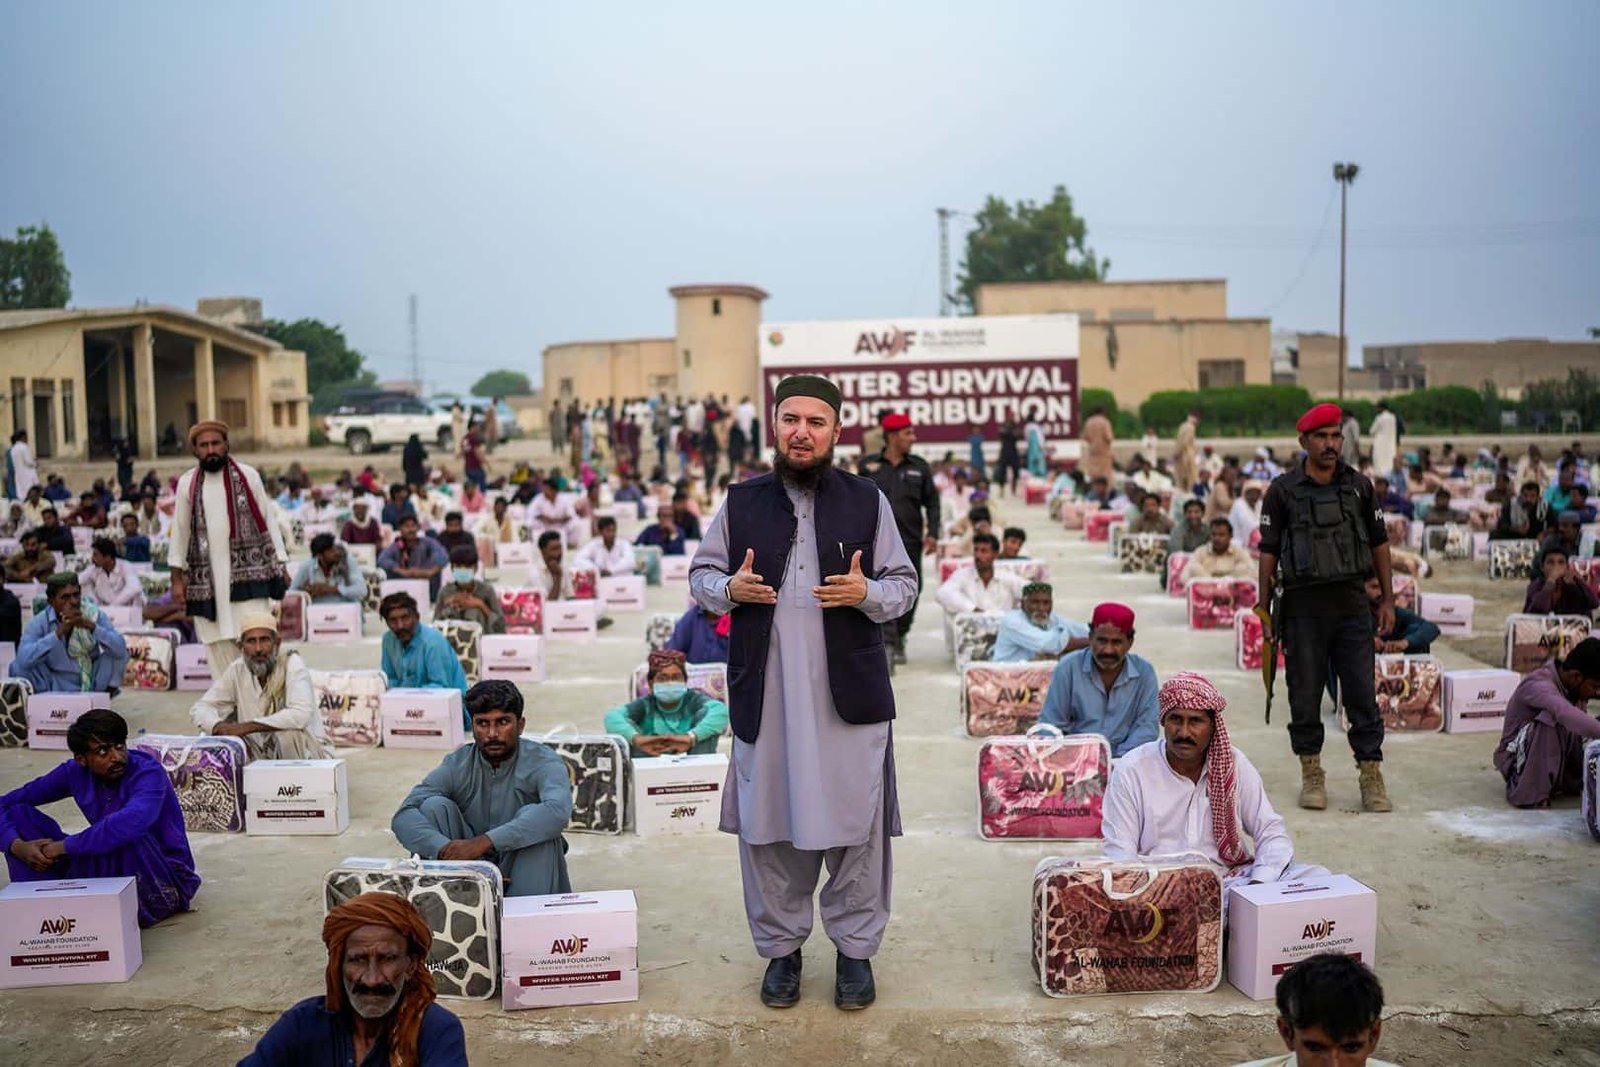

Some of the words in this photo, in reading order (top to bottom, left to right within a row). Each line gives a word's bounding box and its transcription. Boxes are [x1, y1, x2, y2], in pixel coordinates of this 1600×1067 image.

[855, 328, 917, 357] AWF
[907, 366, 1071, 396] SURVIVAL
[319, 693, 358, 713] AWF
[996, 686, 1040, 706] AWF
[277, 784, 303, 797] AWF
[1018, 771, 1075, 796] AWF
[40, 916, 76, 936] AWF
[1103, 903, 1179, 942] AWF
[1301, 918, 1336, 940] AWF
[551, 935, 588, 956] AWF
[567, 955, 611, 964] FOUNDATION
[1074, 954, 1128, 969] AL-WAHAB
[1130, 954, 1196, 968] FOUNDATION
